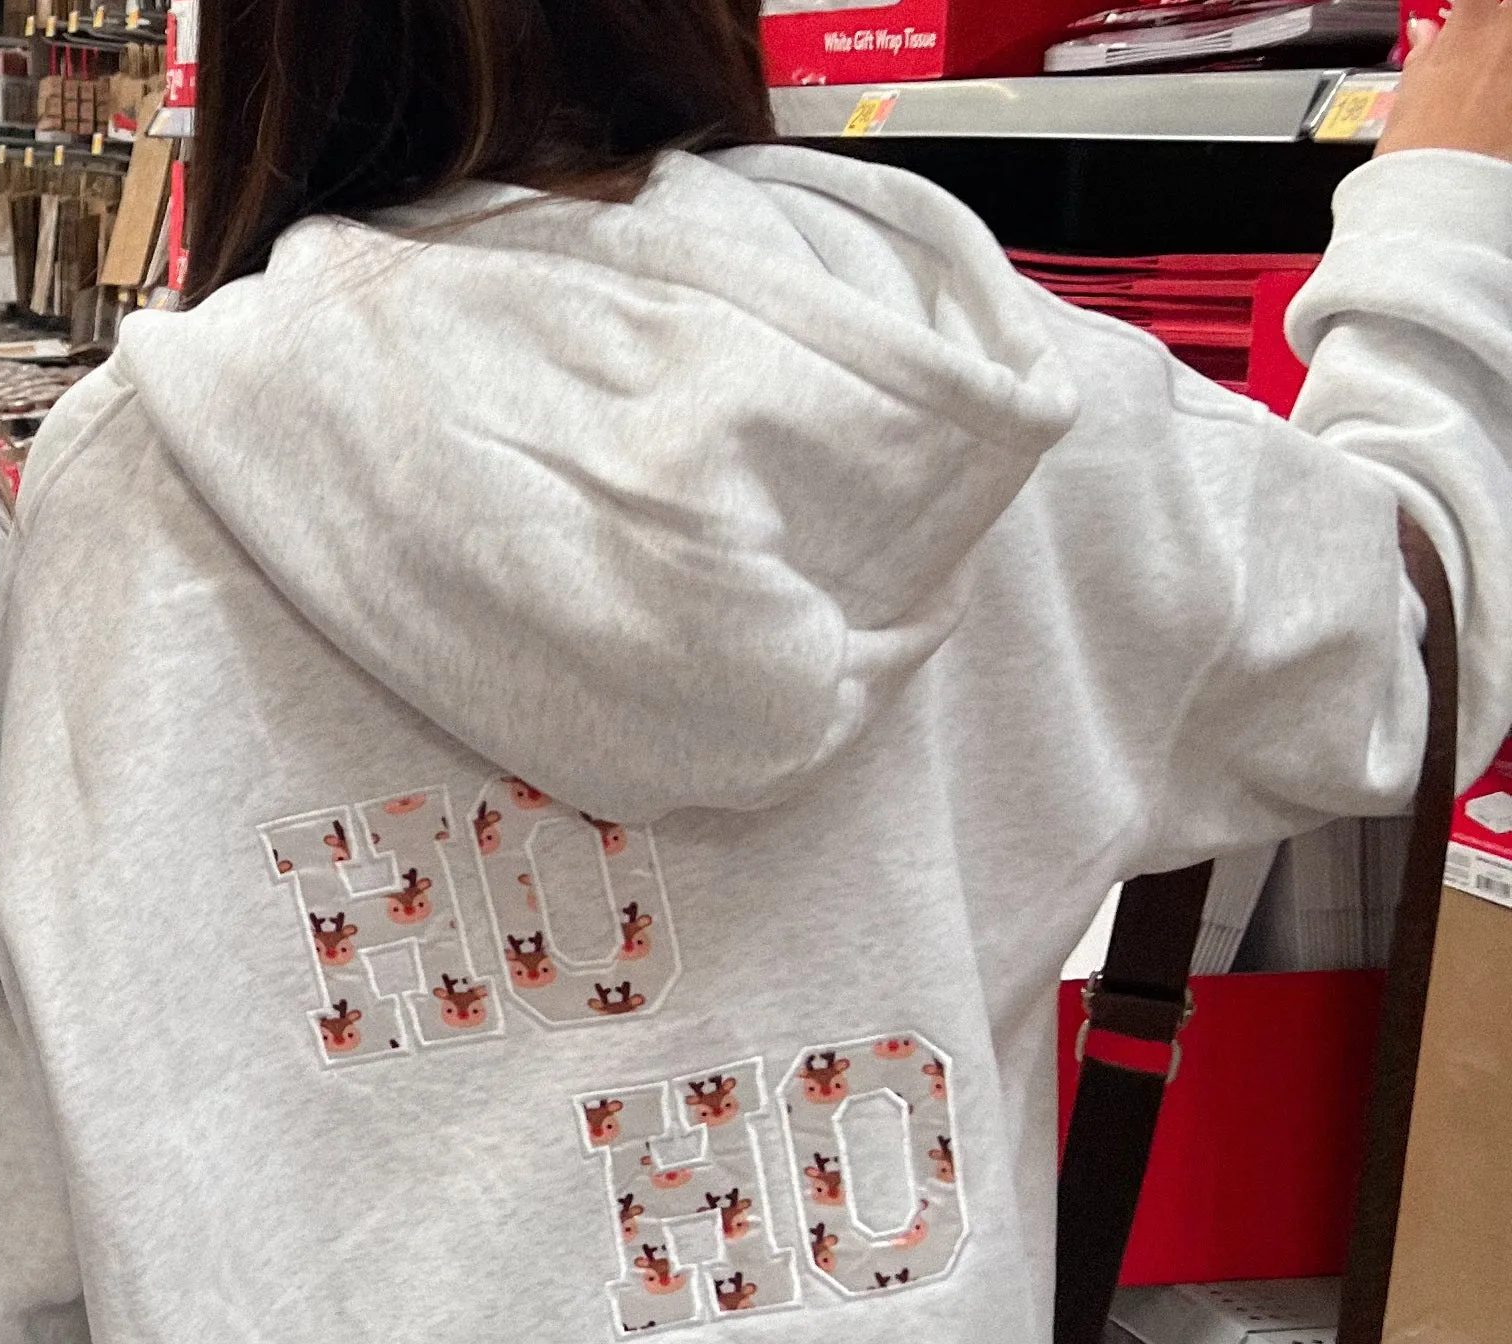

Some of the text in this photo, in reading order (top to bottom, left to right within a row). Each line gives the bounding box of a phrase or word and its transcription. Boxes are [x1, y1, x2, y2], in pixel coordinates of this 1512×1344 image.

[824, 27, 937, 56] White Gift Wrap Tissue
[257, 778, 683, 1067] HO
[573, 1030, 970, 1340] HO
